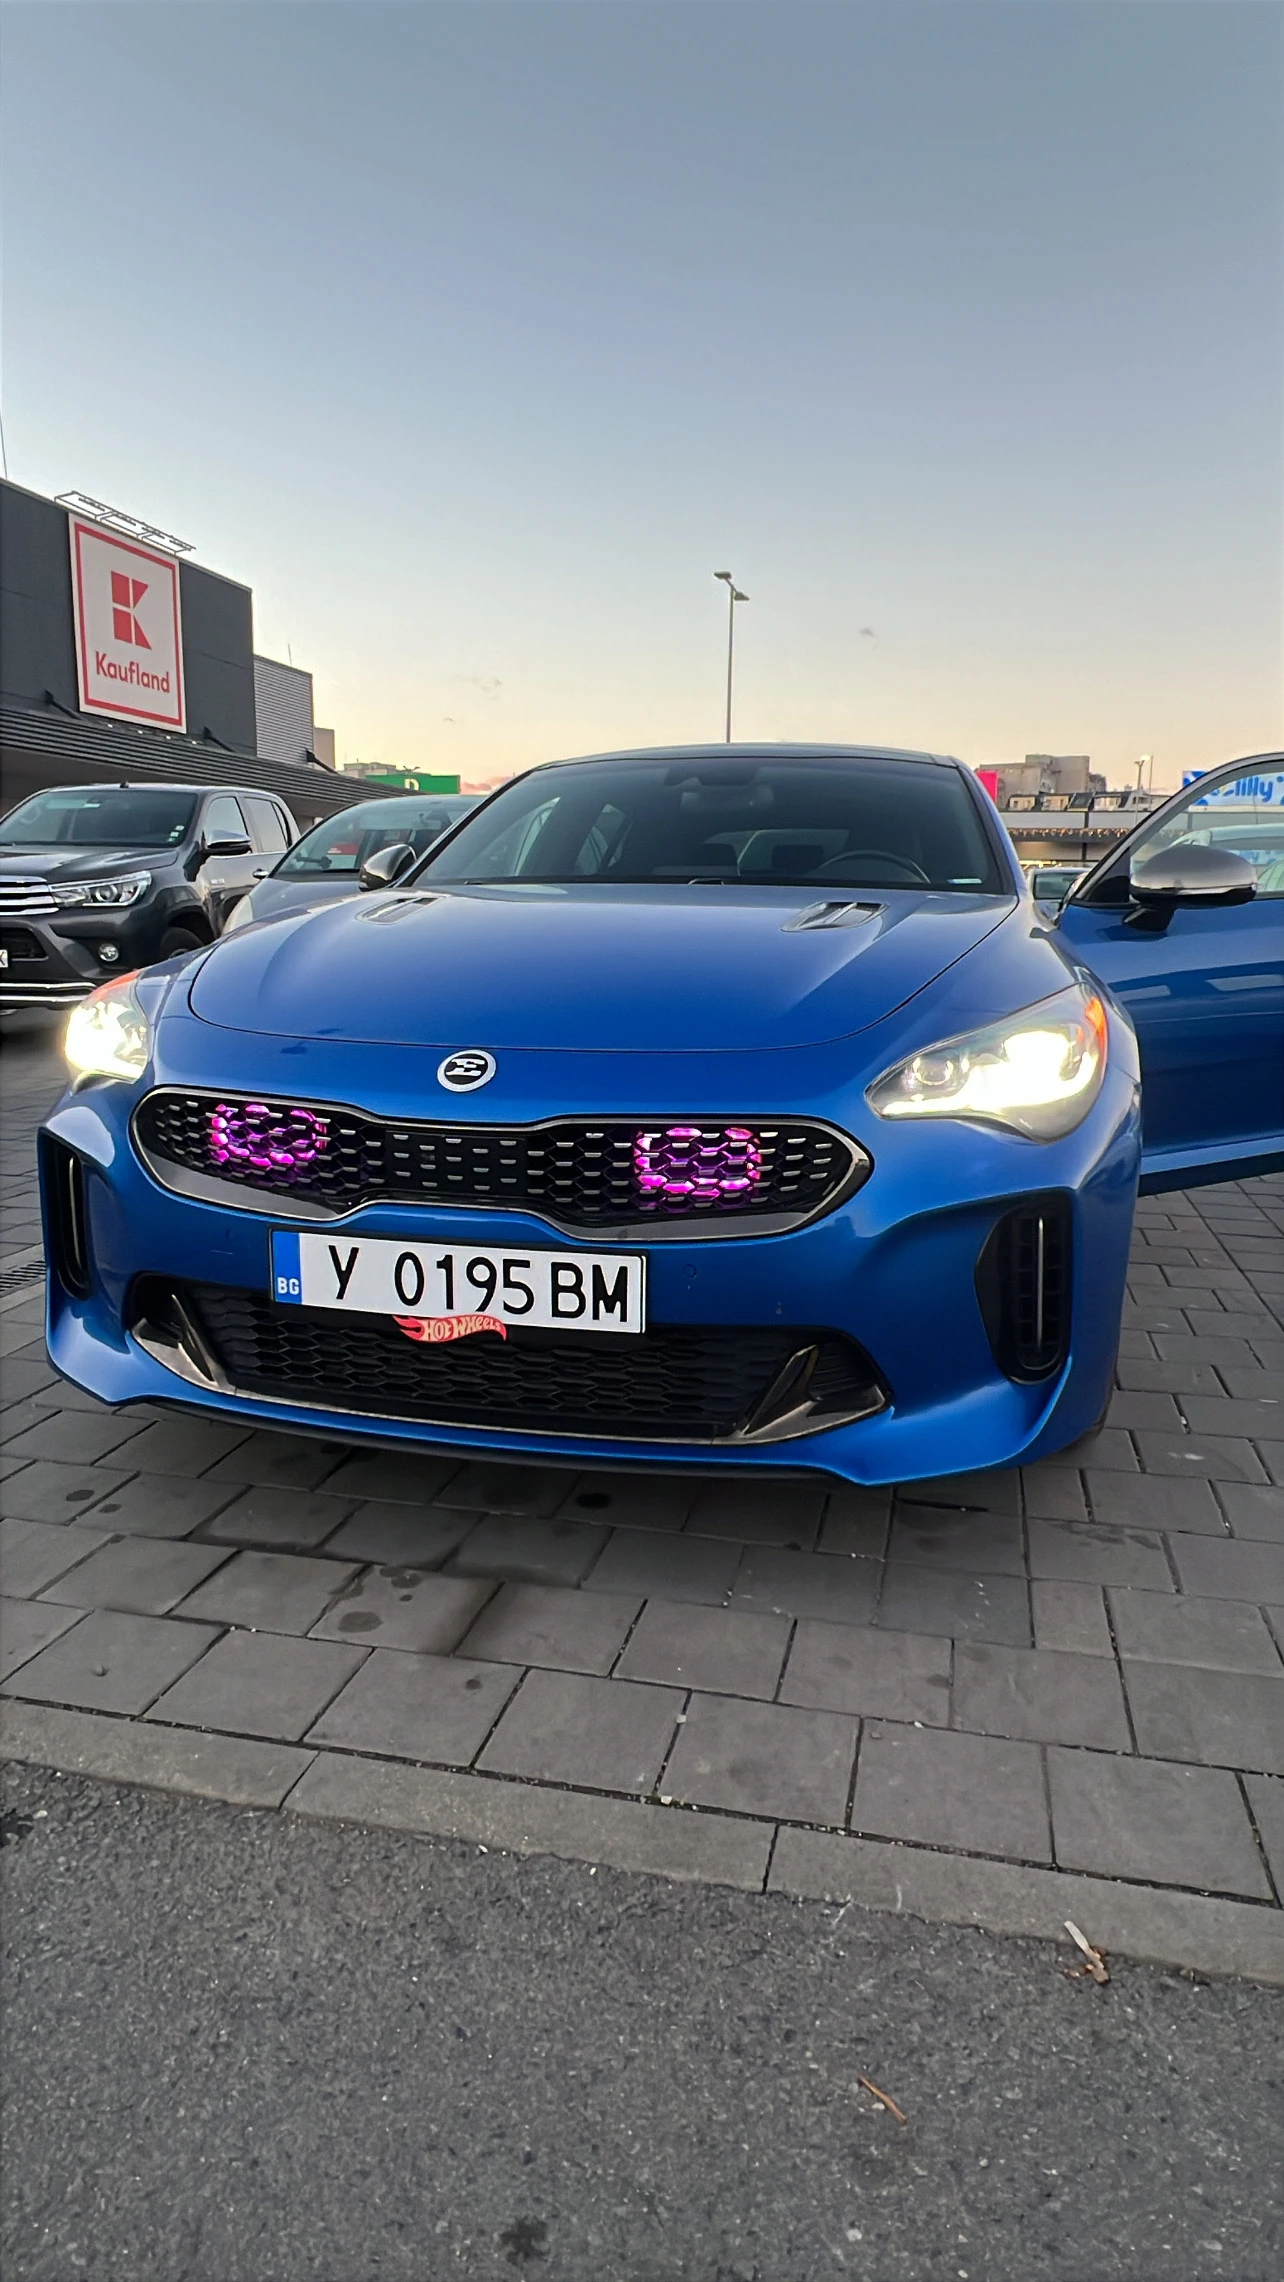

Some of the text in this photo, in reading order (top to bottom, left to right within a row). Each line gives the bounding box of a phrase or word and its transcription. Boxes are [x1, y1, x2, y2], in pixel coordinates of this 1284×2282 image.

[111, 571, 152, 650] K
[95, 651, 170, 693] Kaufland
[277, 1276, 300, 1295] BG
[394, 1251, 535, 1315] 0195
